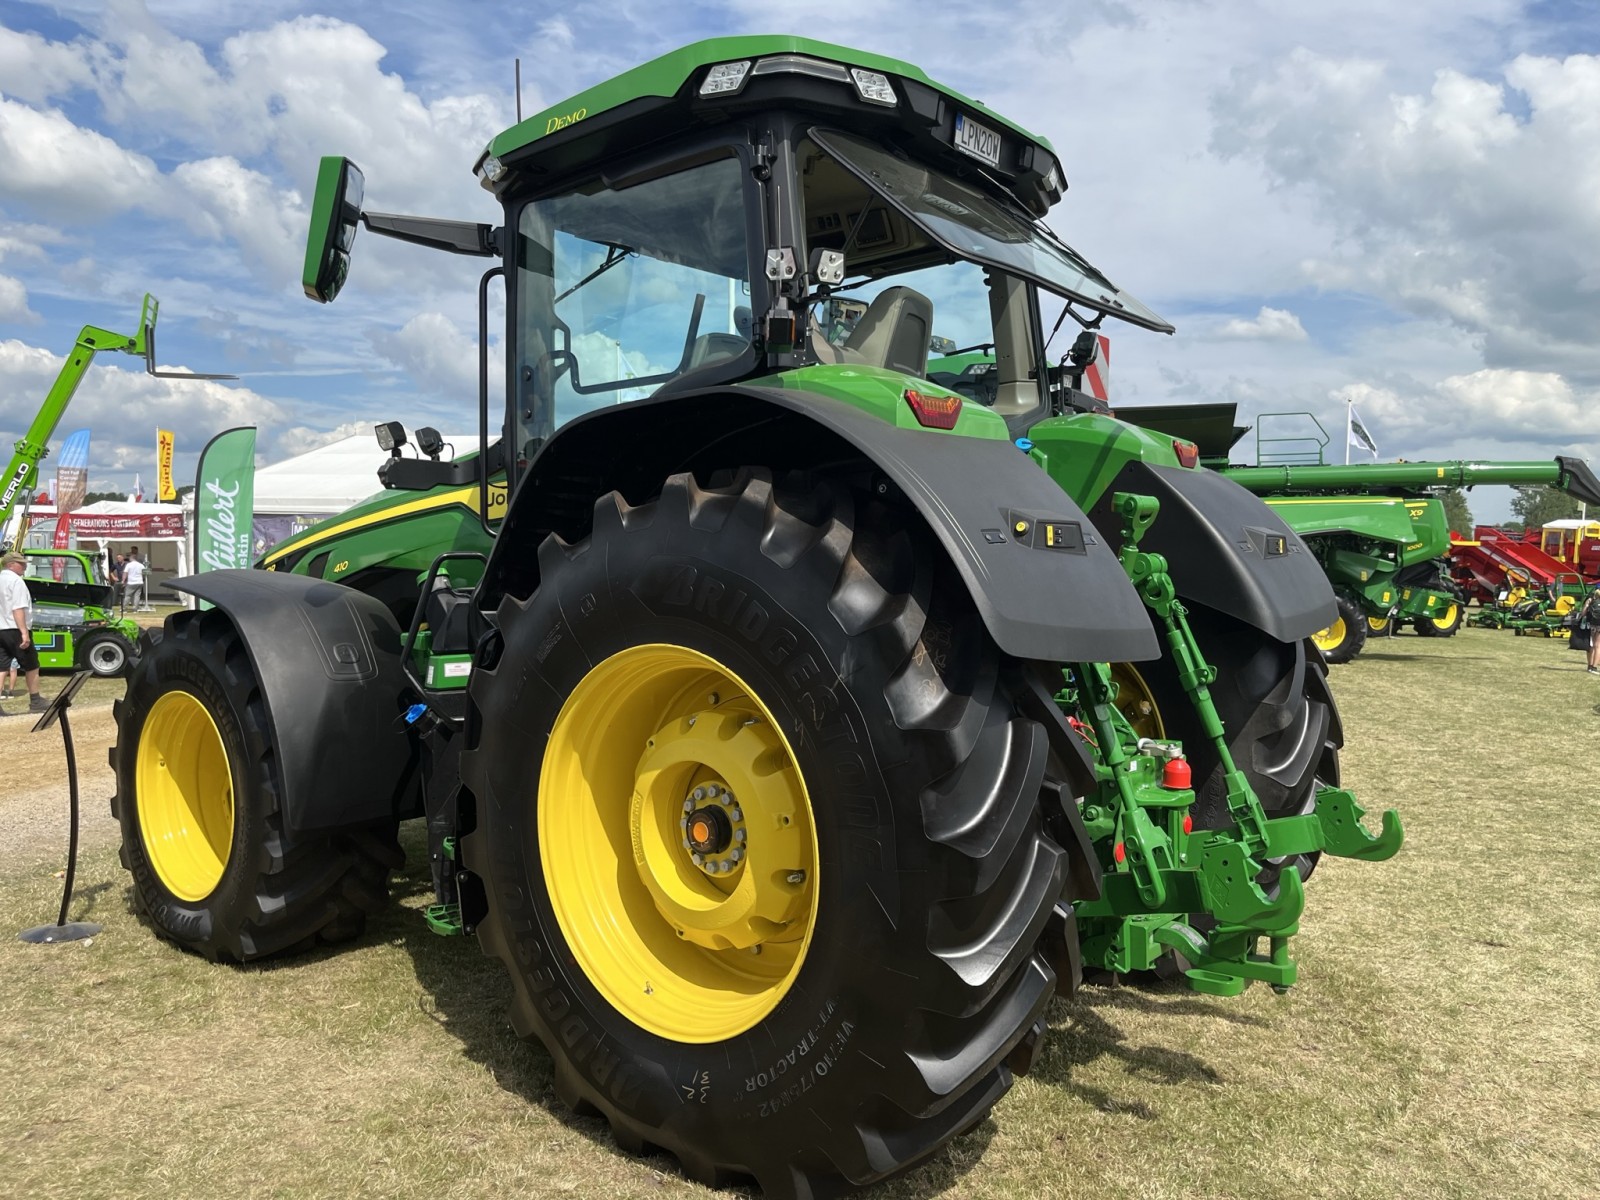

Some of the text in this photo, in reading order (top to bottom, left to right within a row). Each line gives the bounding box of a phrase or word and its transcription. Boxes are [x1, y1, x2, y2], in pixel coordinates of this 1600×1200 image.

[545, 108, 587, 135] DEMO
[0, 463, 29, 511] MERLO
[1409, 509, 1424, 517] X9
[333, 560, 349, 573] 410
